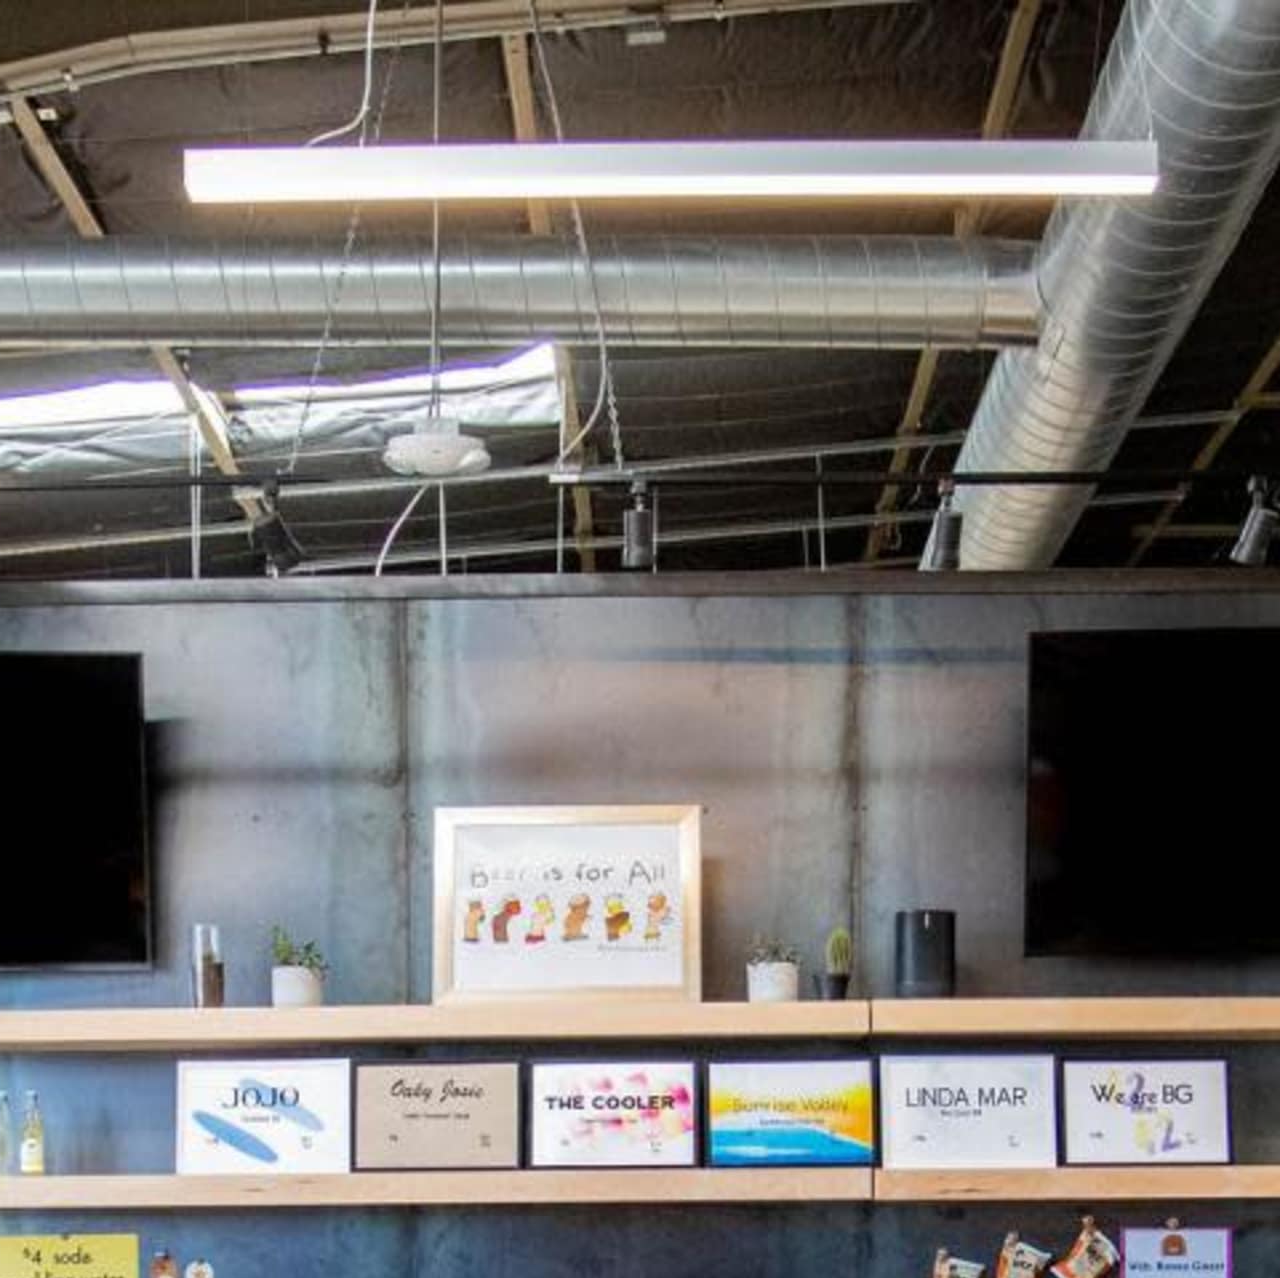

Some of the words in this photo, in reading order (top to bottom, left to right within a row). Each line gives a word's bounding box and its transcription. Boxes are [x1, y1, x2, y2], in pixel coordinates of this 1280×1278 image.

[543, 864, 564, 882] is
[576, 863, 614, 882] for
[628, 859, 665, 886] All
[222, 1086, 301, 1109] JOJO
[545, 1095, 585, 1110] THE
[591, 1095, 675, 1110] COOLER
[905, 1087, 970, 1107] LINDA
[977, 1087, 1028, 1107] MAR
[1090, 1084, 1125, 1105] We
[1161, 1084, 1194, 1105] BG
[53, 1246, 93, 1265] soda
